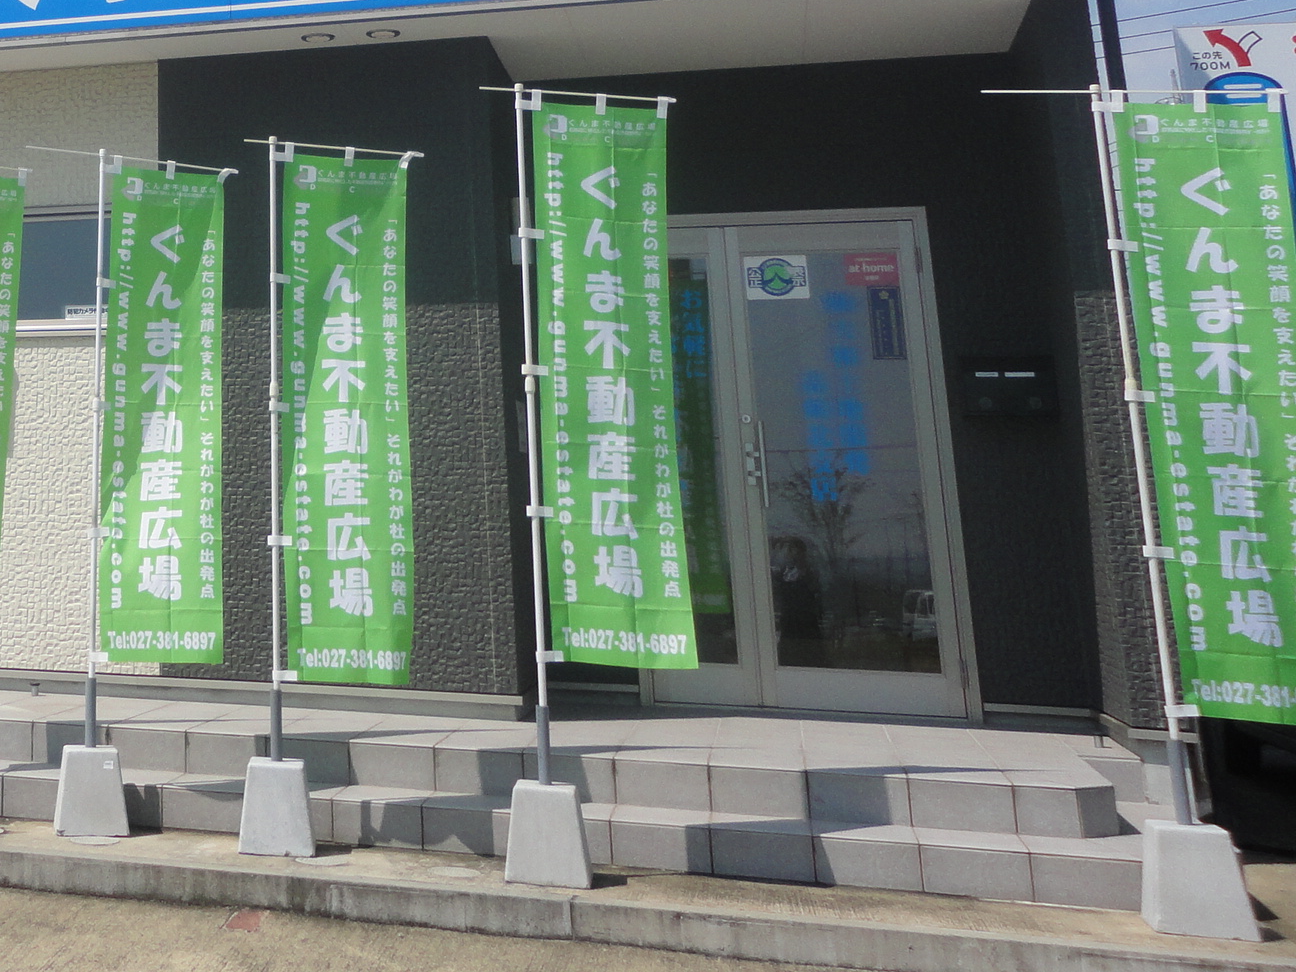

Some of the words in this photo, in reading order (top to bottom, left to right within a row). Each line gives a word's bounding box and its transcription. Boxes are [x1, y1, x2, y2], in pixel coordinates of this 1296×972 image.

[1189, 61, 1231, 71] 700M
[1192, 51, 1223, 60] この先
[111, 212, 136, 609] http://www.gunma-estate.com
[138, 224, 185, 601] ぐんま不動産広場
[290, 202, 312, 625] http://www.gunma-estate.com
[321, 214, 373, 617] ぐんま不動産広場
[544, 152, 578, 603] http://www.gunma-estate.com
[580, 165, 643, 598] ぐんま不動産広場
[1133, 158, 1207, 651] http://www.gunma-estate.com
[1180, 167, 1284, 647] ぐんま不動産広場
[108, 631, 216, 651] Tel:027-381-6897
[297, 648, 407, 670] Tel:027-381-6897
[562, 627, 687, 655] Tel:027-381-6897
